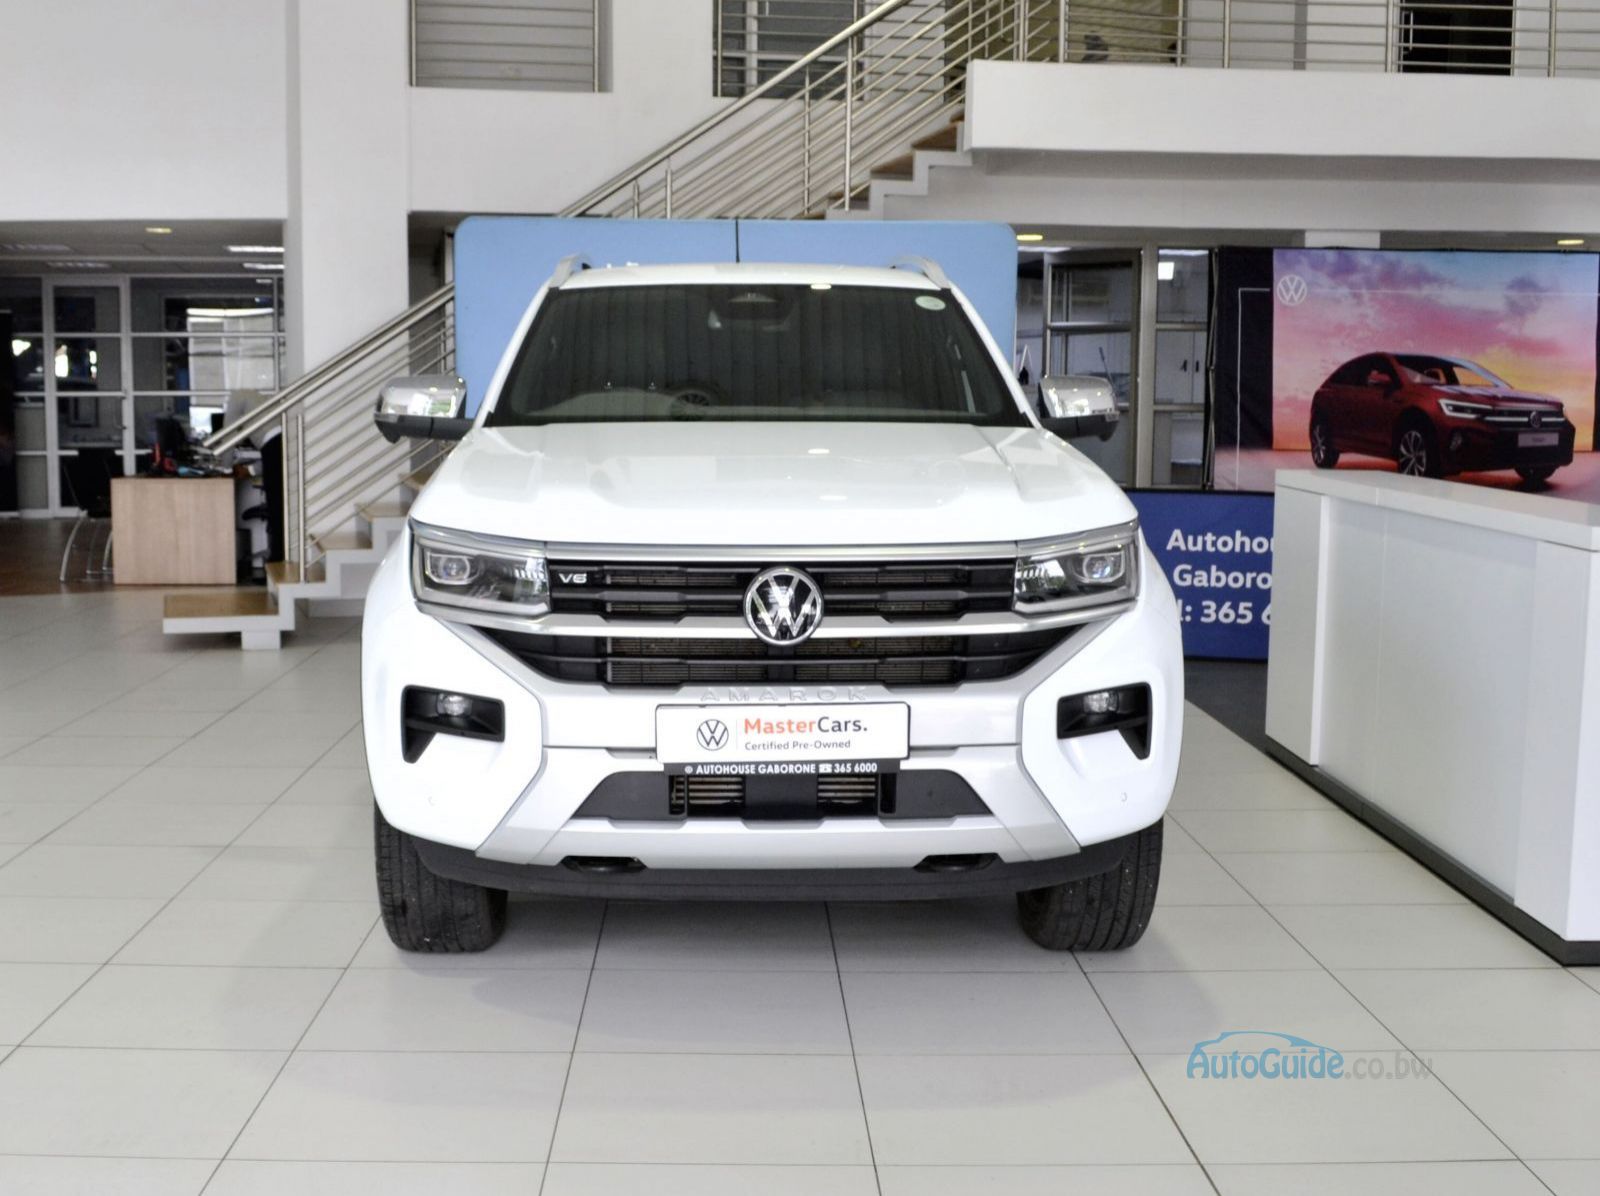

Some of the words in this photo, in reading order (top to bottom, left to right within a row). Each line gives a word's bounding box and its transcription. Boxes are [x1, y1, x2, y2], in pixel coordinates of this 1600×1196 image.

[1166, 529, 1273, 553] Autoho
[559, 573, 587, 583] V6
[1173, 564, 1272, 589] Gaboro
[1200, 600, 1253, 624] 365
[700, 687, 867, 702] AMAROK
[744, 716, 868, 735] MasterCars.
[745, 740, 790, 751] Certified
[792, 739, 851, 750] Pre-Owned
[696, 763, 756, 775] AUTOHOUSE
[758, 763, 816, 774] GABORONE
[834, 763, 851, 773] 365
[854, 762, 878, 773] 6000
